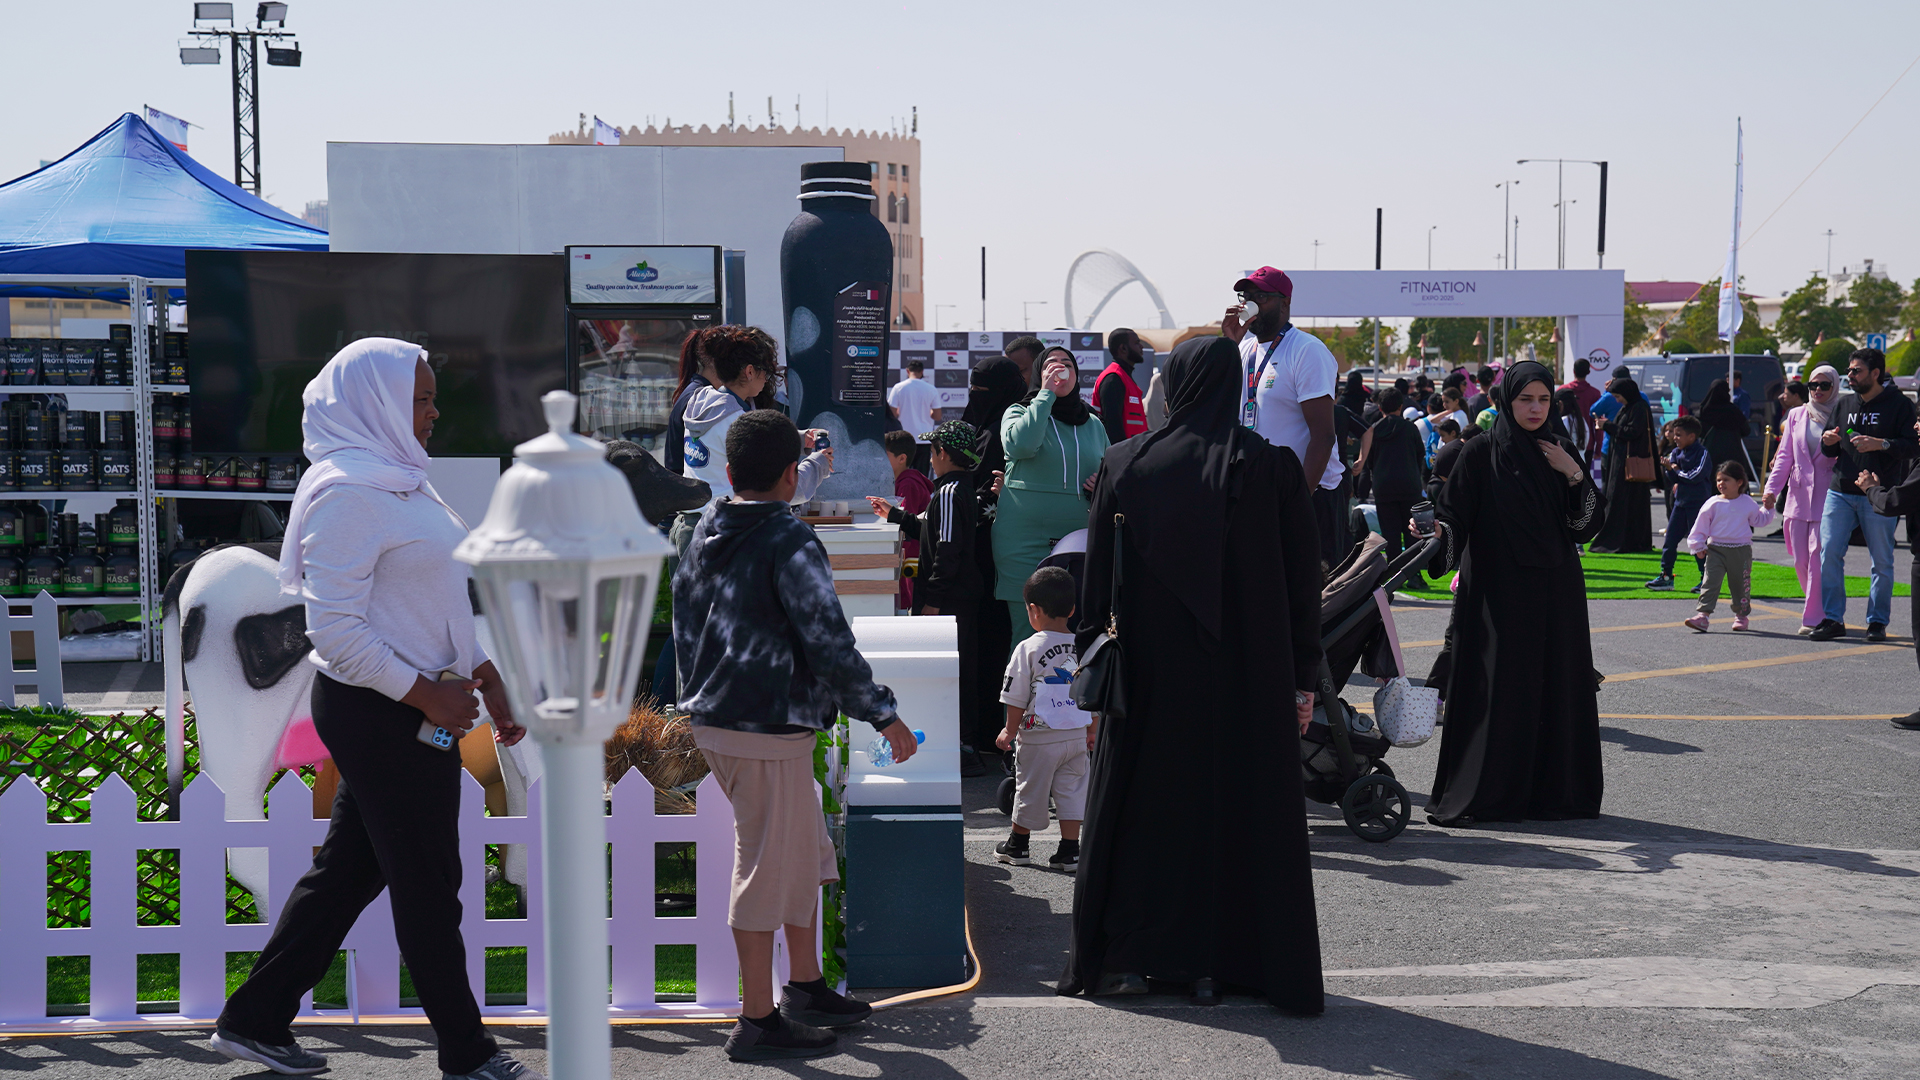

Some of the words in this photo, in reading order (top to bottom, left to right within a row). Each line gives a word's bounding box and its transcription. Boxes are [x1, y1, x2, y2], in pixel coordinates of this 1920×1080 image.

[1400, 281, 1476, 293] FITNATION
[1847, 412, 1880, 425] NKE
[21, 464, 43, 474] OATS
[62, 463, 88, 474] OATS
[103, 464, 130, 474] OATS
[112, 525, 136, 534] MASS
[27, 577, 52, 585] MASS
[106, 575, 129, 584] MASS
